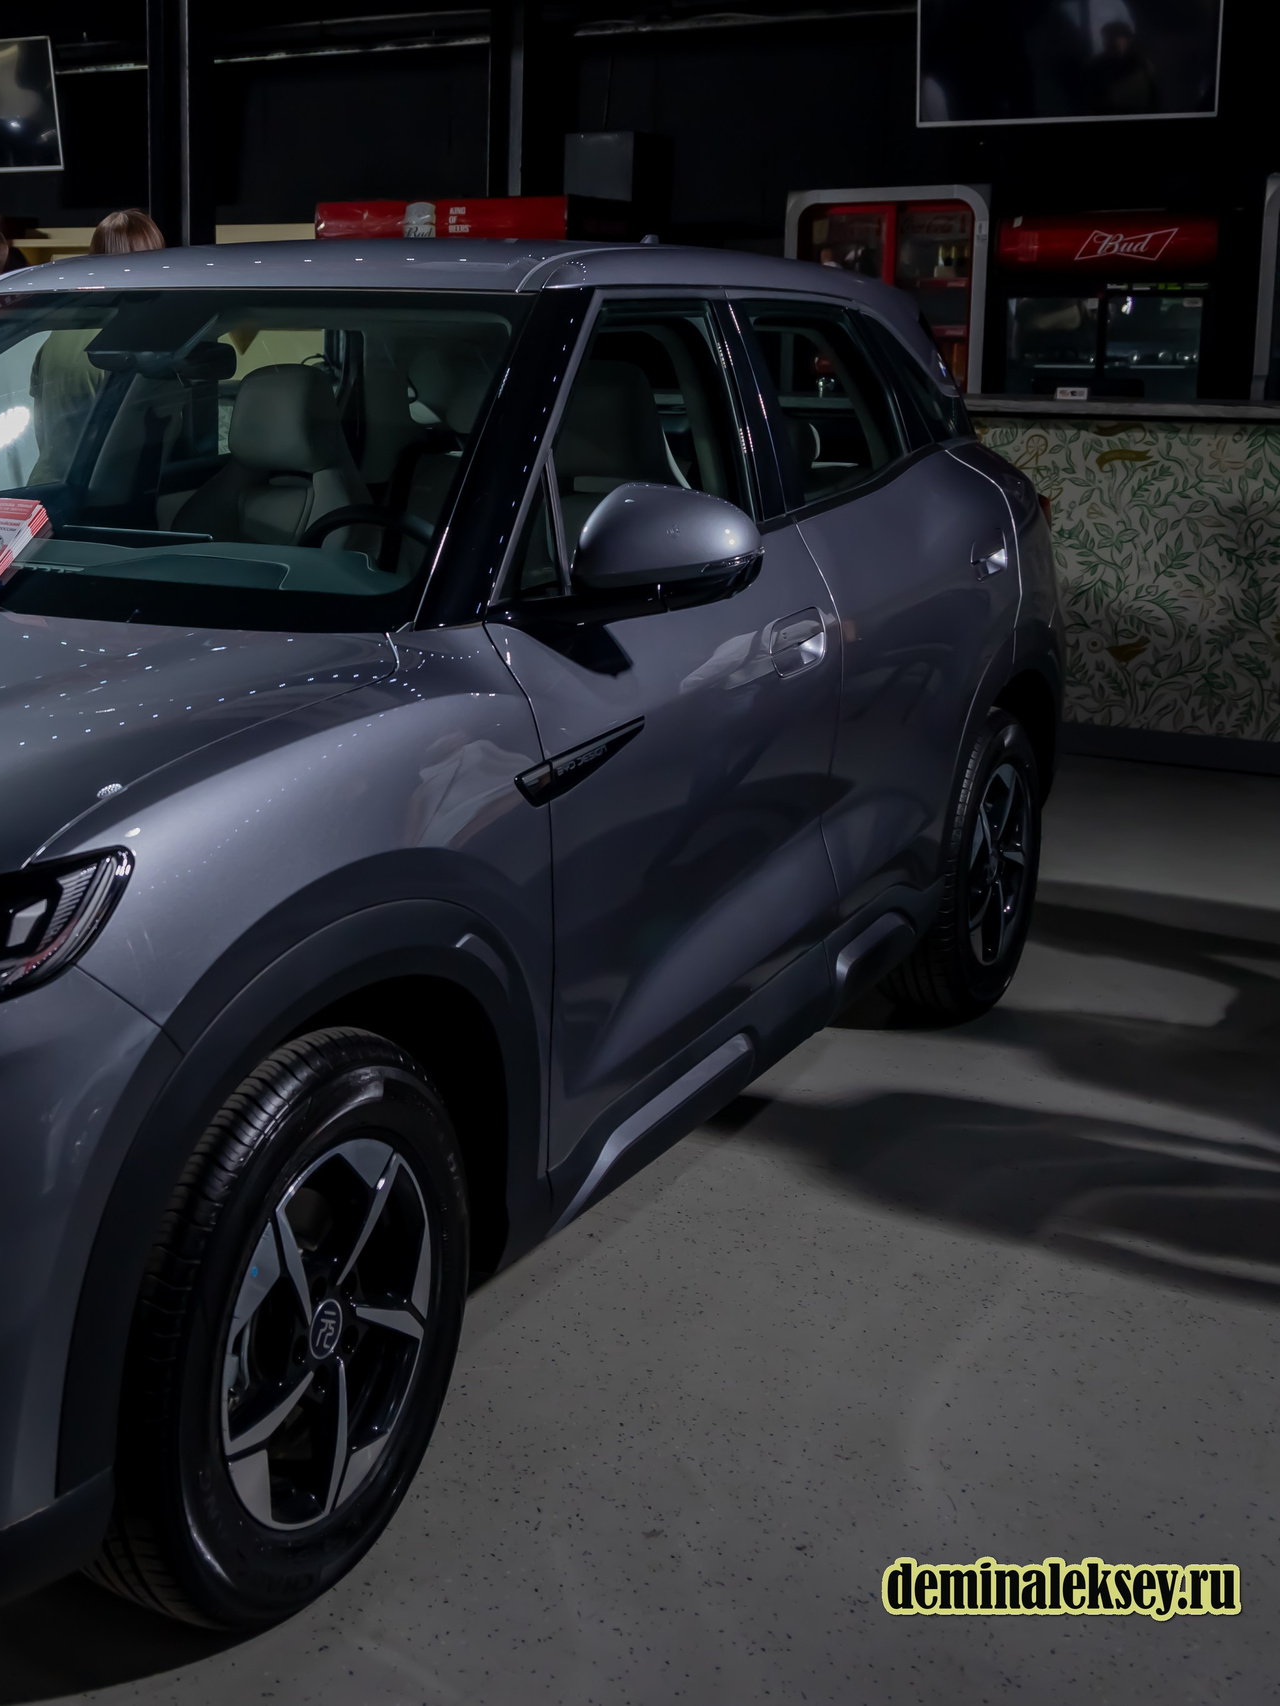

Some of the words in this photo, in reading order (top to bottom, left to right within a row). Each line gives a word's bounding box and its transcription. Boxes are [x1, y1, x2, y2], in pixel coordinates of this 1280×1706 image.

[449, 206, 466, 215] KING
[448, 215, 458, 224] OF
[1092, 232, 1150, 256] Bud
